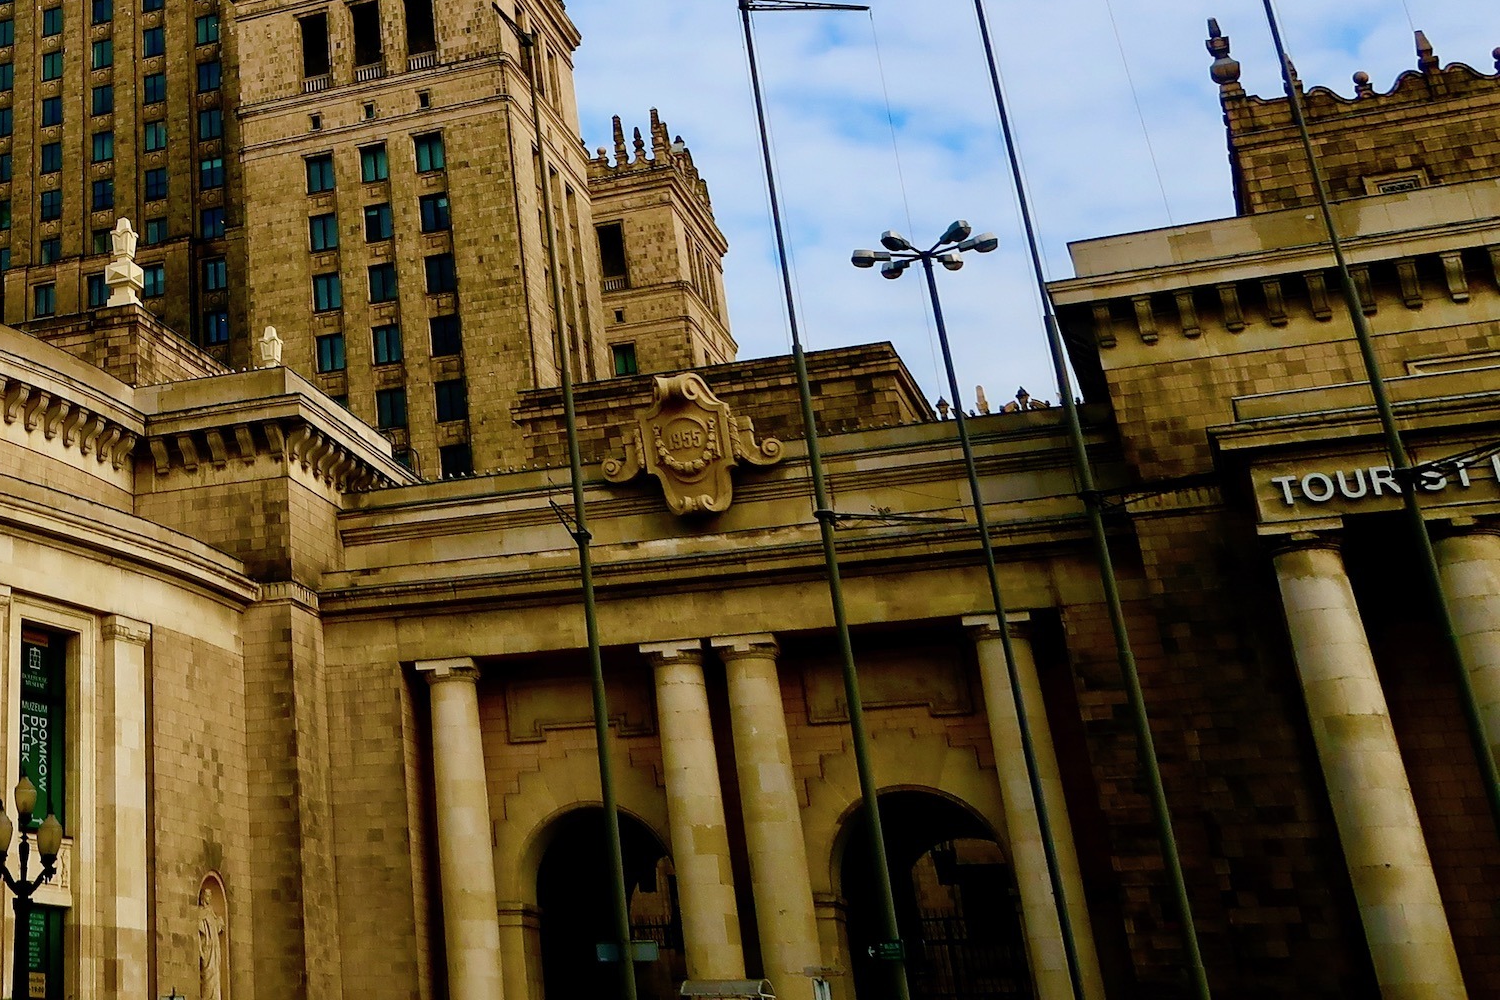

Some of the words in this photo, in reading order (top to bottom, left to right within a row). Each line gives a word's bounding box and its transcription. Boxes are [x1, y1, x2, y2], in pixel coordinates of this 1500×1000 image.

[669, 430, 701, 450] 1955
[1271, 455, 1479, 505] TOURST
[21, 700, 48, 714] MUZEUM
[21, 713, 30, 763] LALEK
[30, 716, 39, 746] DLA
